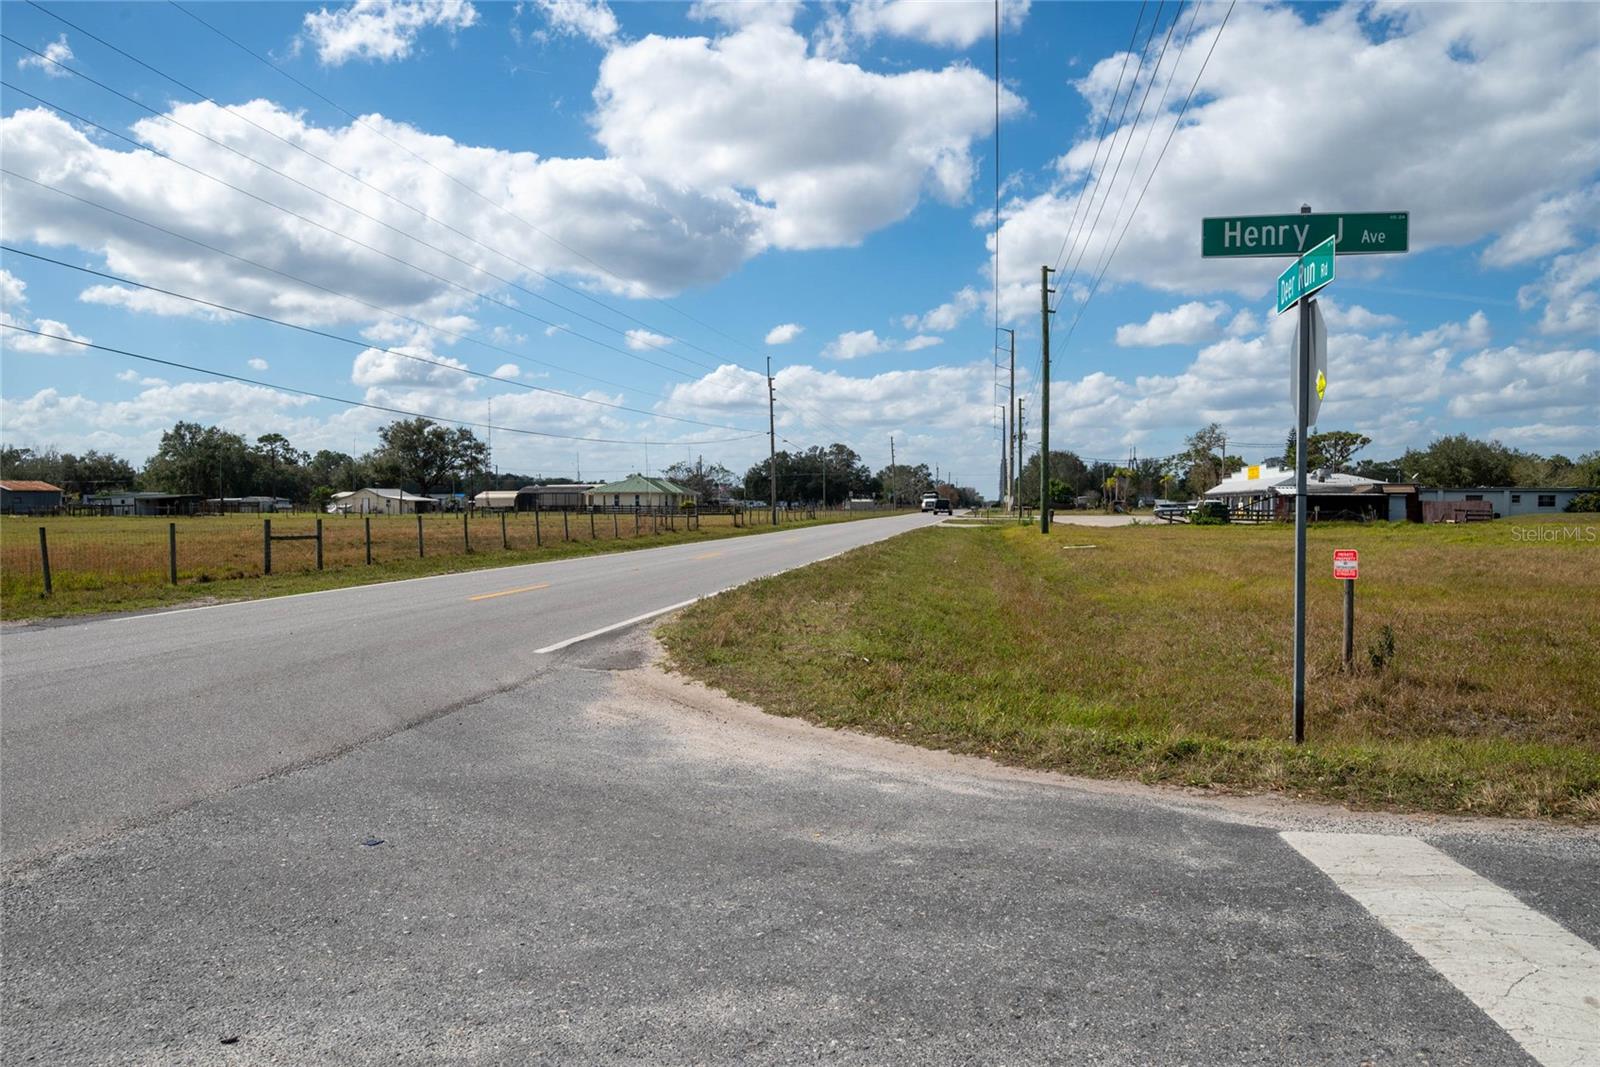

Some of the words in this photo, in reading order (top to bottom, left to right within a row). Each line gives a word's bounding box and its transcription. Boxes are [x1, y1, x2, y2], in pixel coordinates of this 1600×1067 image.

[1224, 221, 1310, 251] Henry
[1335, 217, 1344, 244] J
[1361, 229, 1386, 244] Ave
[1281, 275, 1295, 305] Deer
[1298, 262, 1316, 292] Run
[1320, 261, 1328, 279] Rd
